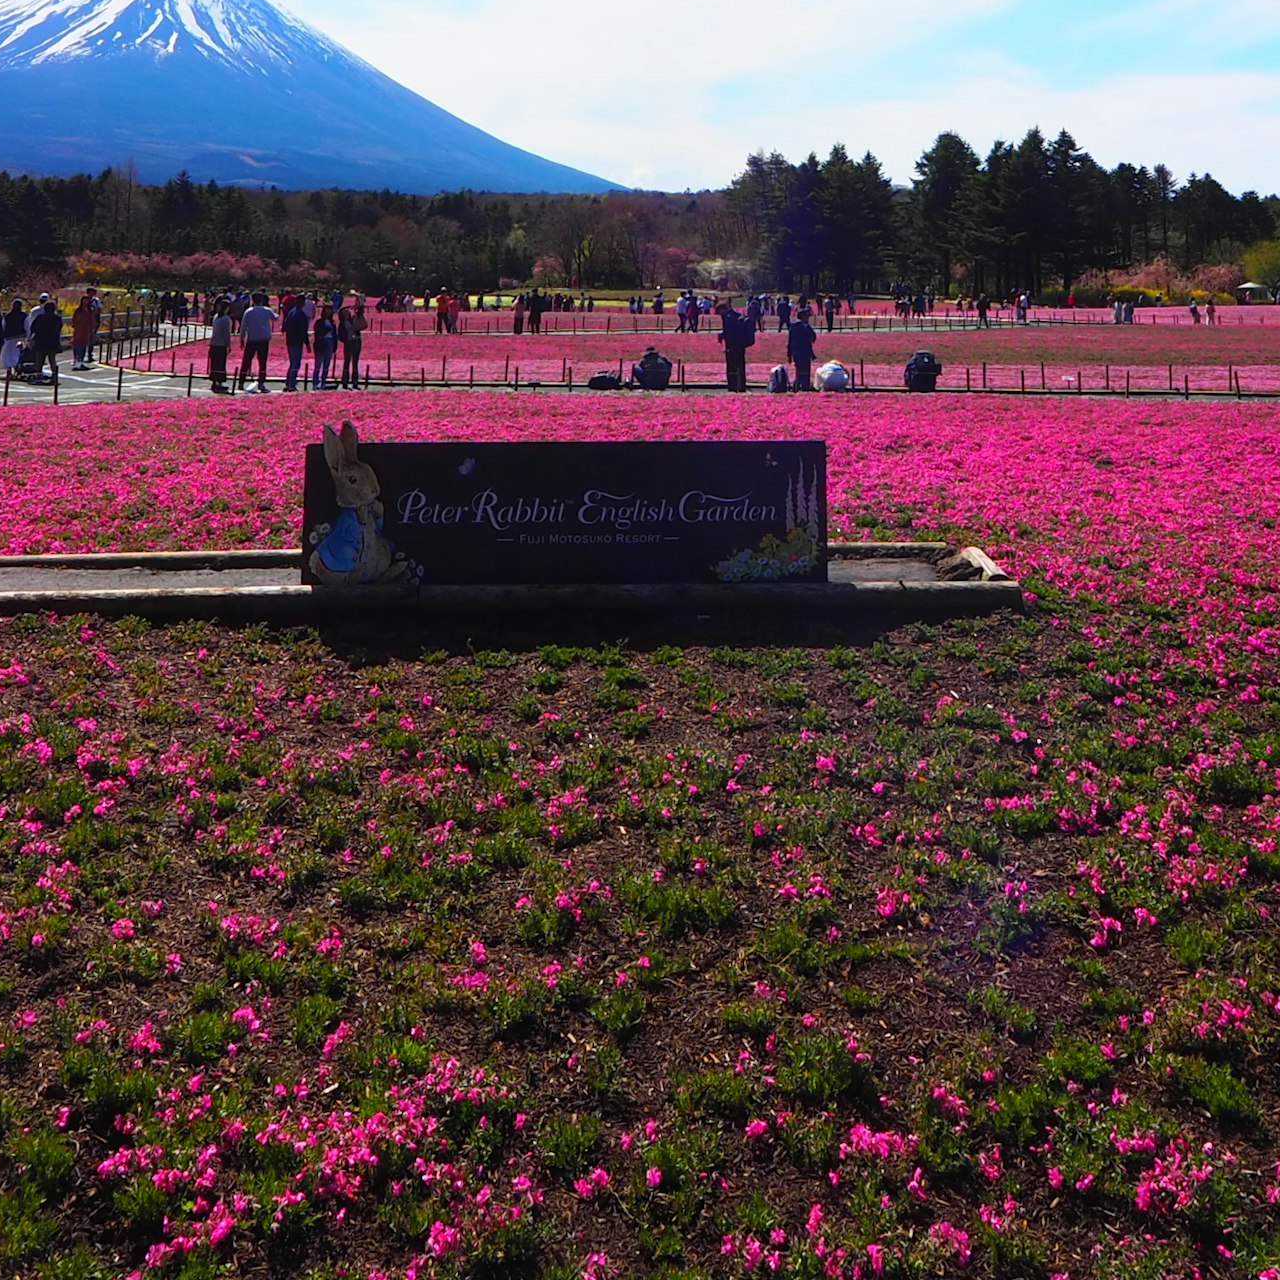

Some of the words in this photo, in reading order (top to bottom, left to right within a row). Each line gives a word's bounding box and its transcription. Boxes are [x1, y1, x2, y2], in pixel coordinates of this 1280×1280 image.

[397, 487, 469, 524] Peter
[471, 487, 566, 530] Rabbit
[577, 489, 674, 530] English
[678, 489, 777, 523] Garden
[519, 534, 546, 545] FUJI
[549, 533, 612, 544] MOTOSUKO
[616, 533, 661, 543] RESORT
